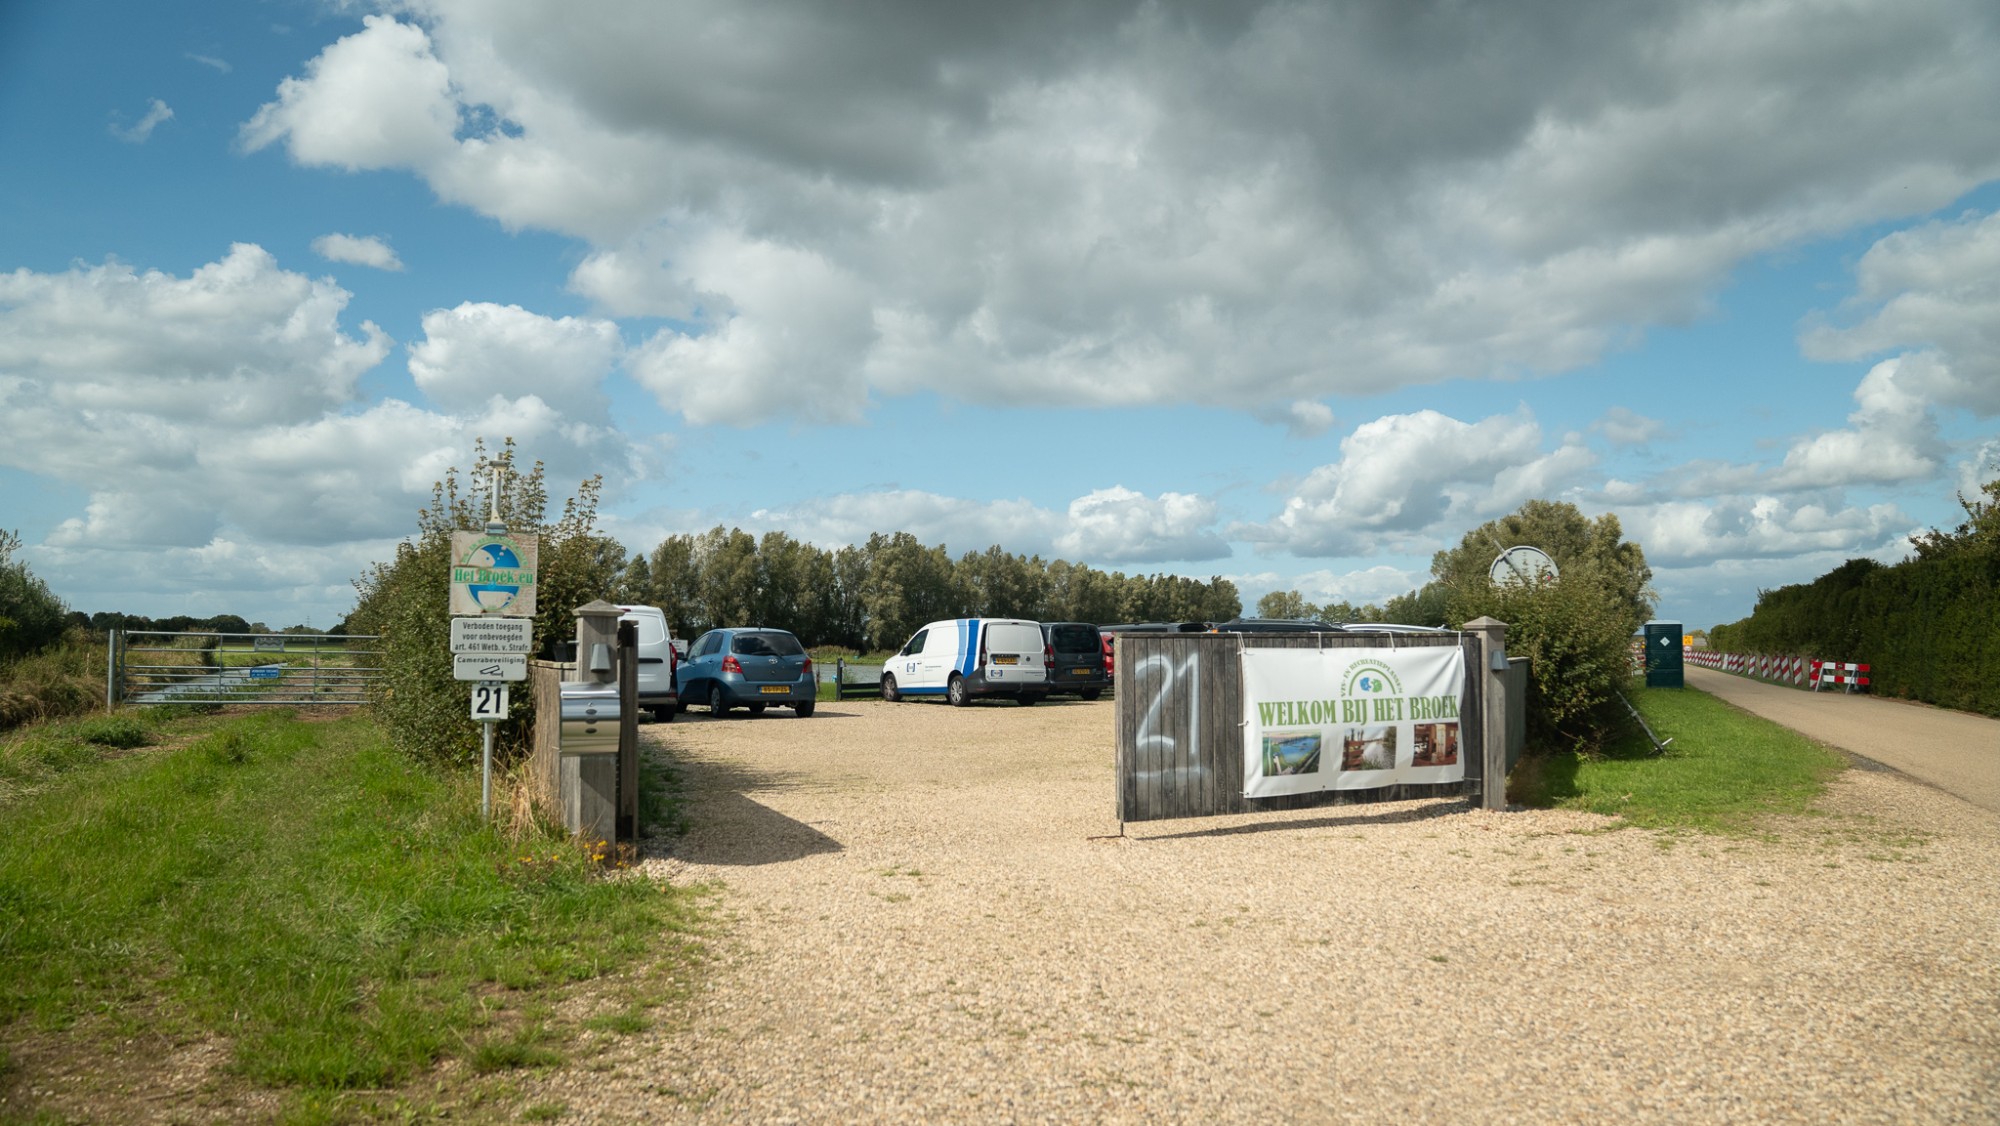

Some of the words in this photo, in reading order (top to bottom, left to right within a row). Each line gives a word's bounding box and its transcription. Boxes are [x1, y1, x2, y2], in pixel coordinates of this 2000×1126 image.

[454, 568, 475, 582] Het
[462, 621, 495, 630] Verboden
[496, 622, 523, 632] toegang
[479, 632, 523, 643] onbevoegden
[455, 643, 467, 651] art.
[468, 643, 480, 651] 461
[481, 643, 501, 651] Wetb.
[508, 643, 530, 651] Strafr.
[457, 656, 526, 665] Camerabeveiliging
[476, 687, 502, 714] 21
[1135, 652, 1199, 756] 21
[1257, 699, 1337, 727] WELKOM
[1342, 698, 1370, 726] BIJ
[1373, 697, 1405, 722] HET
[1409, 695, 1459, 720] BROEK
